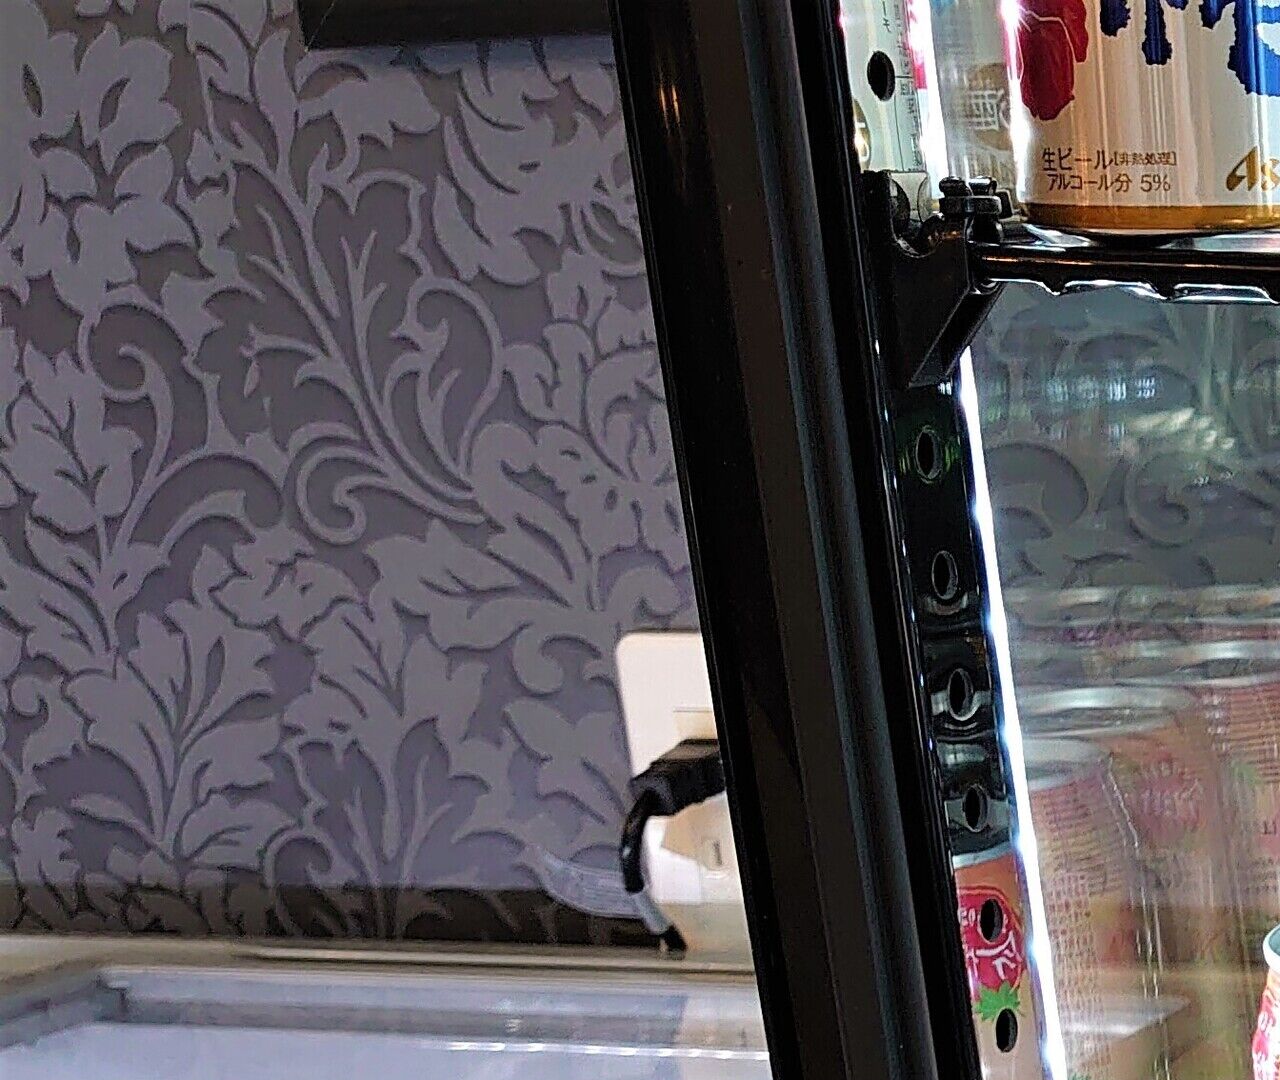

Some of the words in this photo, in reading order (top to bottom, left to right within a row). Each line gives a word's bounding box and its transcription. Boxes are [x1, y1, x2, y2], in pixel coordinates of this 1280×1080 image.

[1046, 172, 1132, 193] アルコール分
[1140, 172, 1172, 193] 5%
